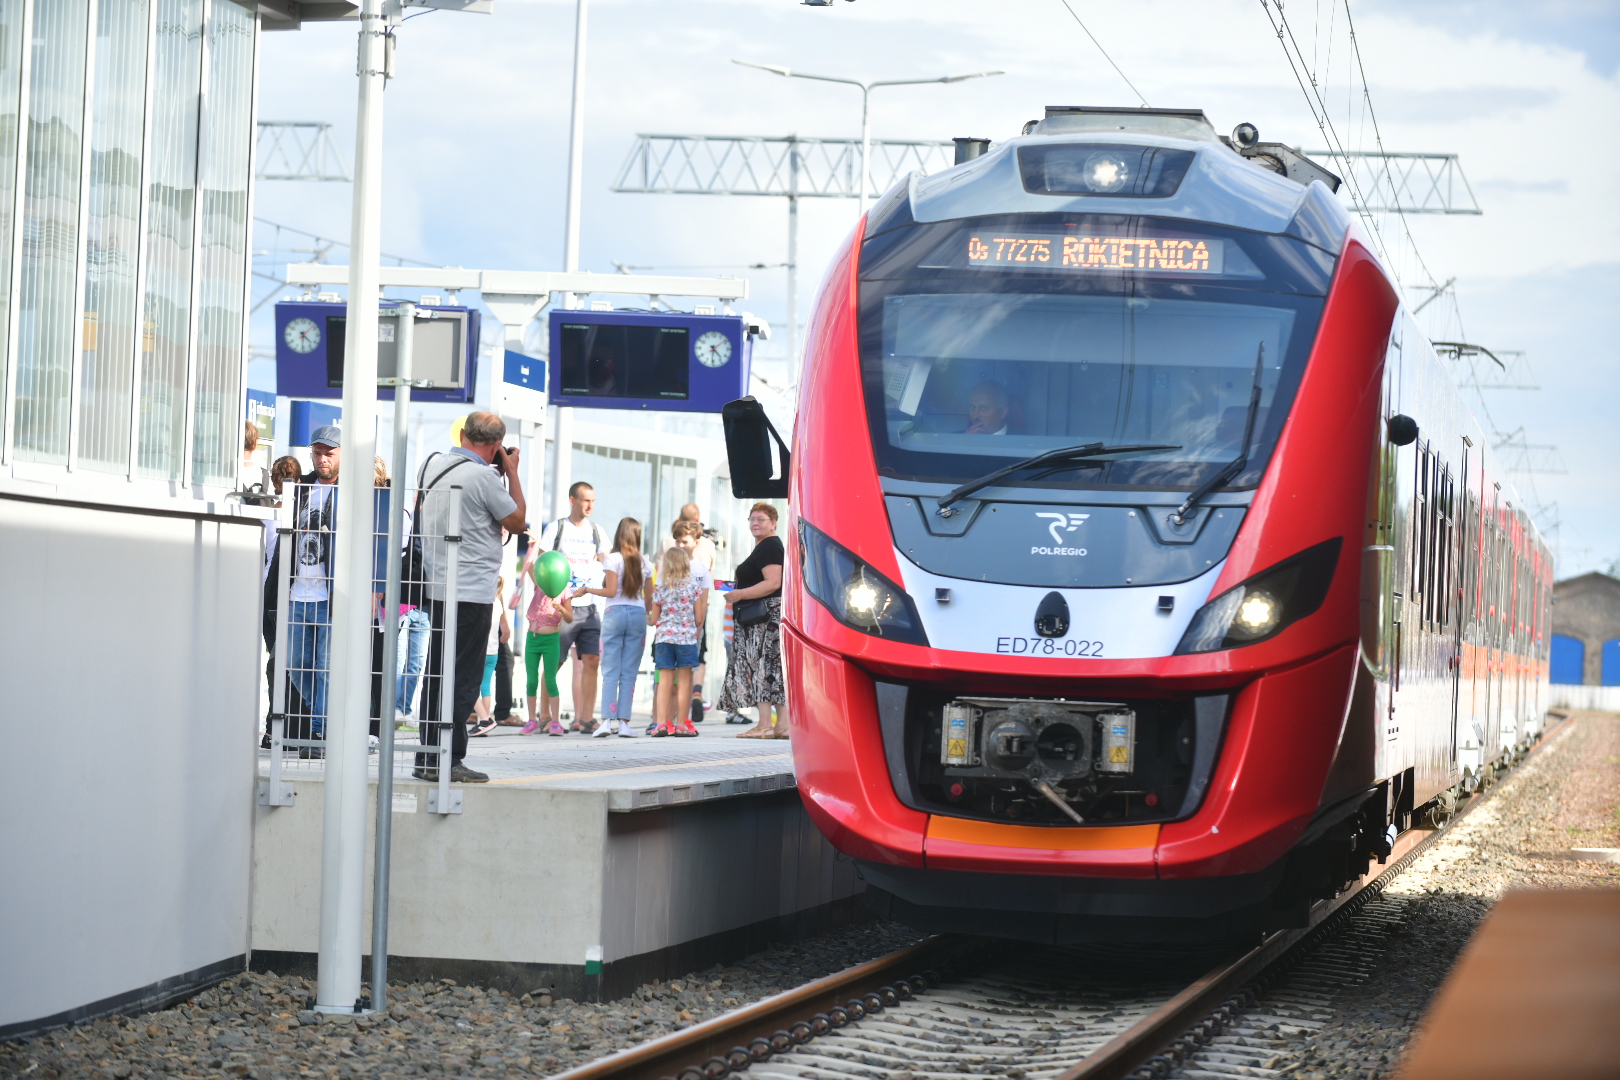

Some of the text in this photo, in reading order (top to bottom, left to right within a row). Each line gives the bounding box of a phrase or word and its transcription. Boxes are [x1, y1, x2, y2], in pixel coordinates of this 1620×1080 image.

[968, 236, 1209, 270] Os 77275 ROKIETNICA
[1031, 547, 1087, 556] POLREGIO
[996, 637, 1104, 657] ED78-022
